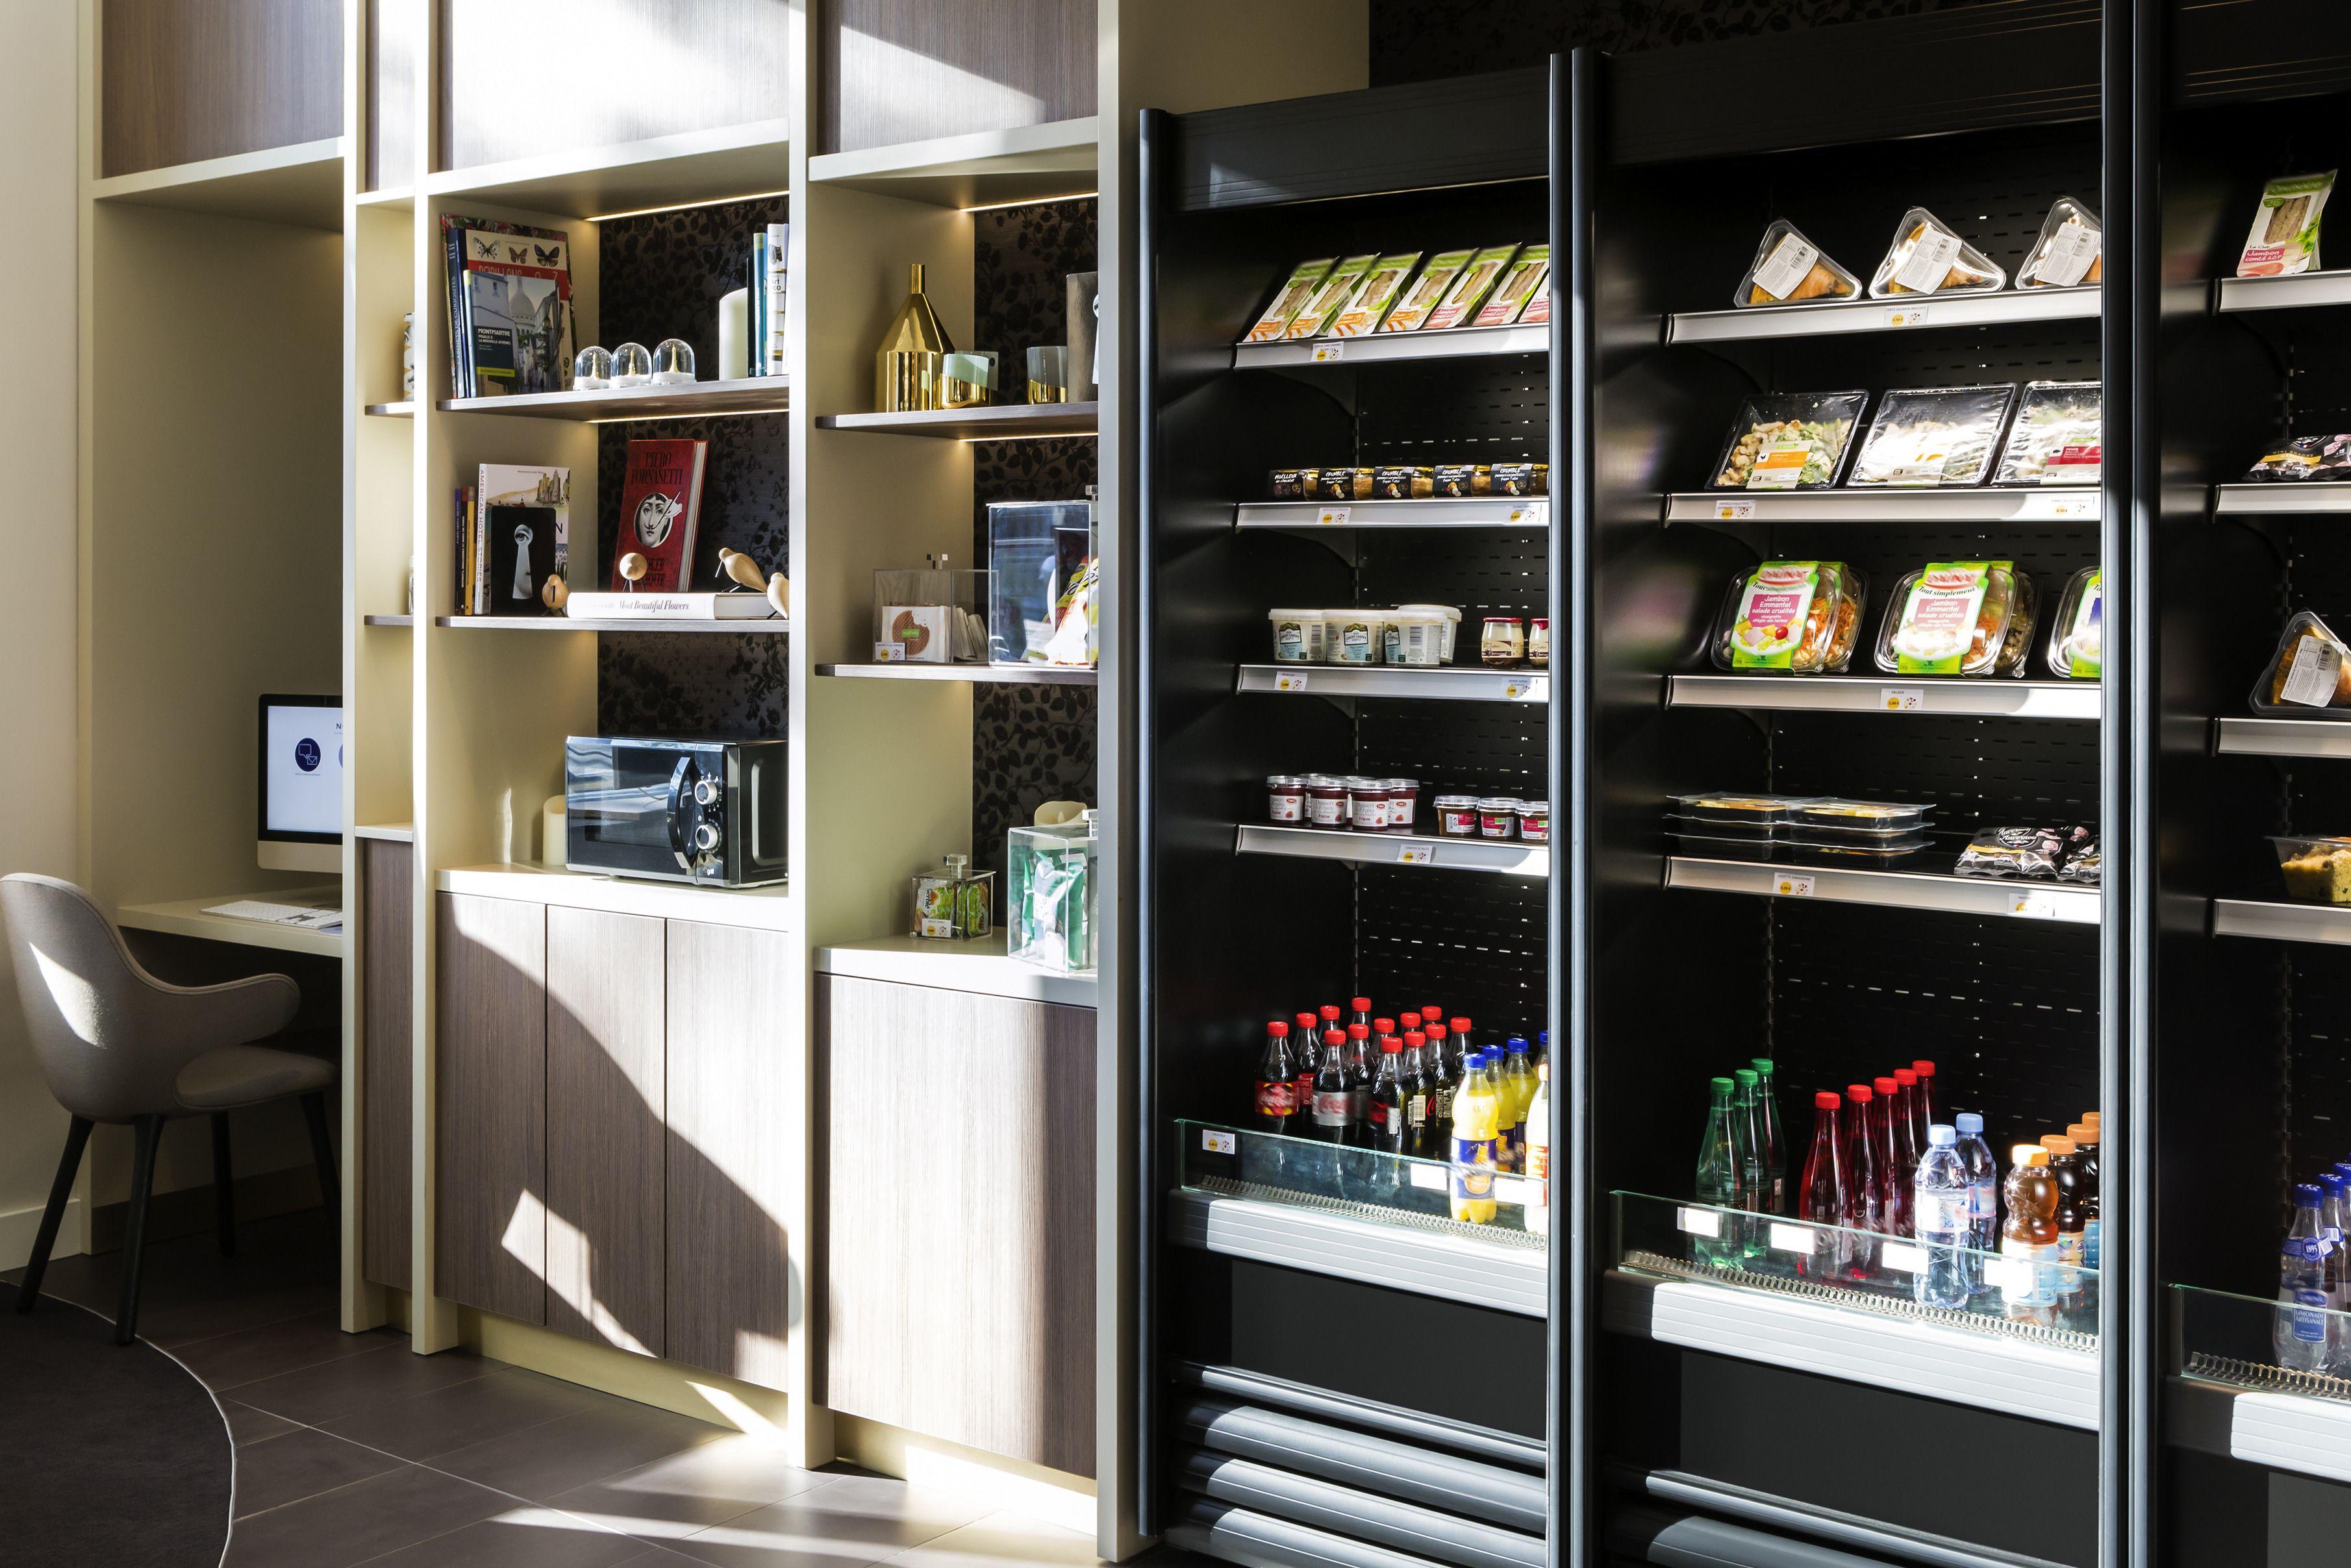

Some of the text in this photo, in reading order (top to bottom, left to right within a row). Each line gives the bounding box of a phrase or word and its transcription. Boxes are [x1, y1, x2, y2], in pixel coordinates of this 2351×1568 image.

[478, 328, 510, 336] MONTMARTRE
[645, 452, 672, 467] PIERO
[631, 469, 683, 484] FORNASETTI
[1918, 586, 1975, 597] Tout simplement
[634, 601, 664, 612] Beautiful
[664, 601, 689, 610] Flowers
[2306, 1245, 2318, 1253] 1895
